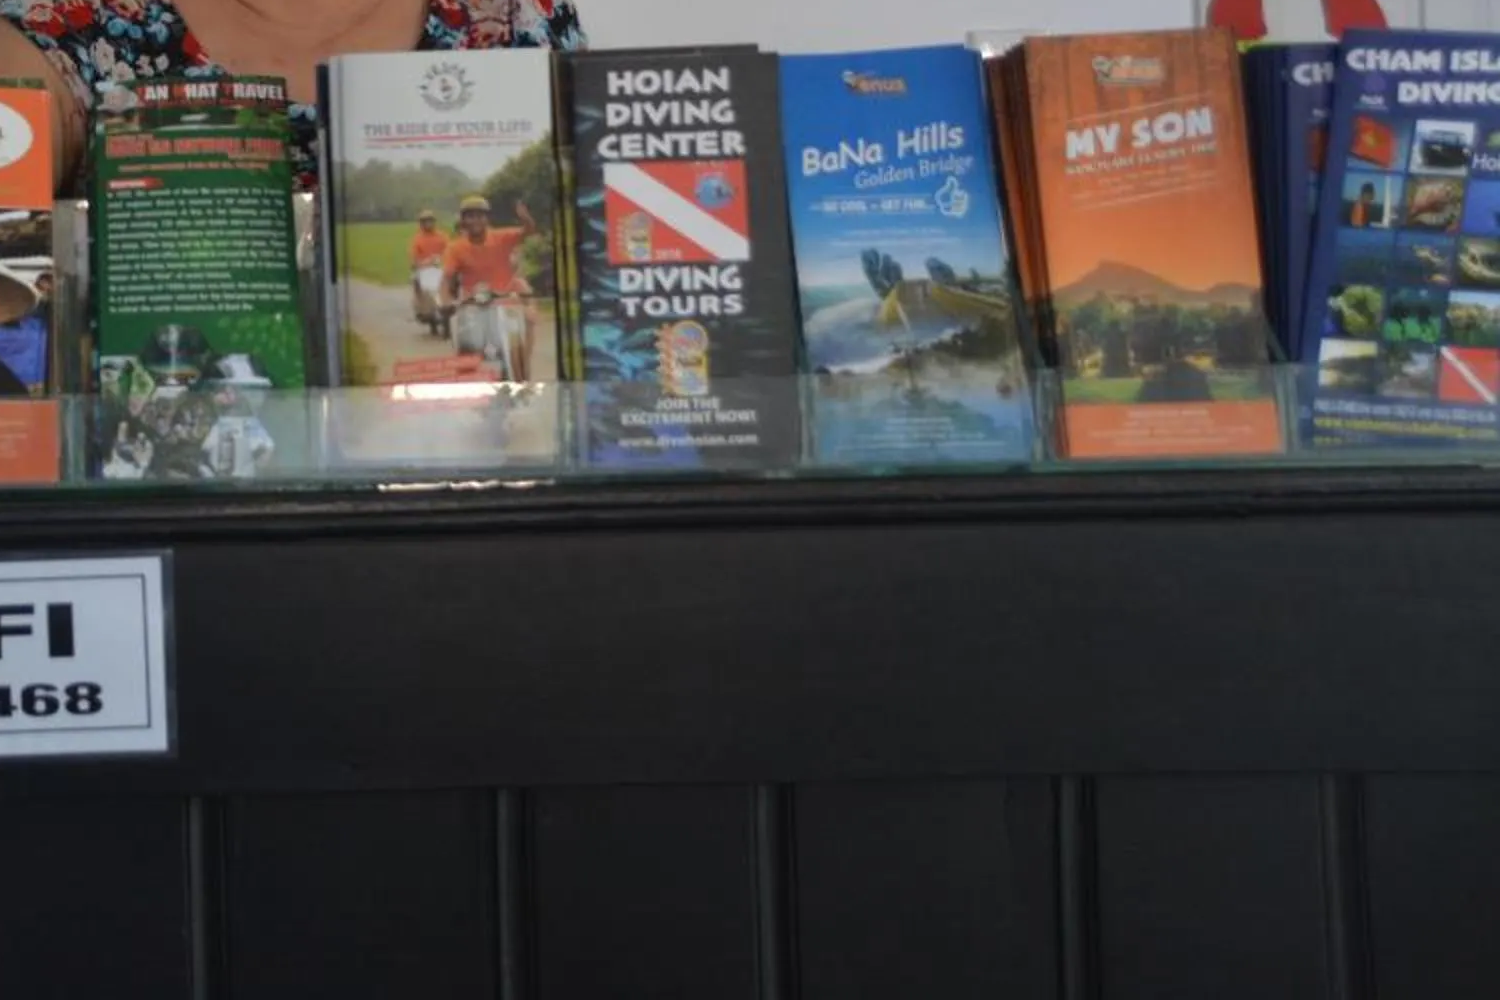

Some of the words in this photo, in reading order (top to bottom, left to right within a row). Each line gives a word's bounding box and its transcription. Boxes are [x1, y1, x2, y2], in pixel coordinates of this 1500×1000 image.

[1291, 61, 1335, 86] CH
[1345, 48, 1444, 72] CHAM
[1448, 48, 1500, 72] ISL
[173, 82, 219, 100] HAT
[606, 66, 731, 96] HOIAN
[604, 99, 737, 128] DIVING
[1131, 105, 1214, 150] SON
[596, 129, 747, 159] CENTER
[802, 137, 884, 177] BaNa
[896, 120, 965, 159] Hills
[853, 166, 916, 190] Golden
[618, 264, 743, 293] DIVING
[619, 293, 744, 318] TOURS
